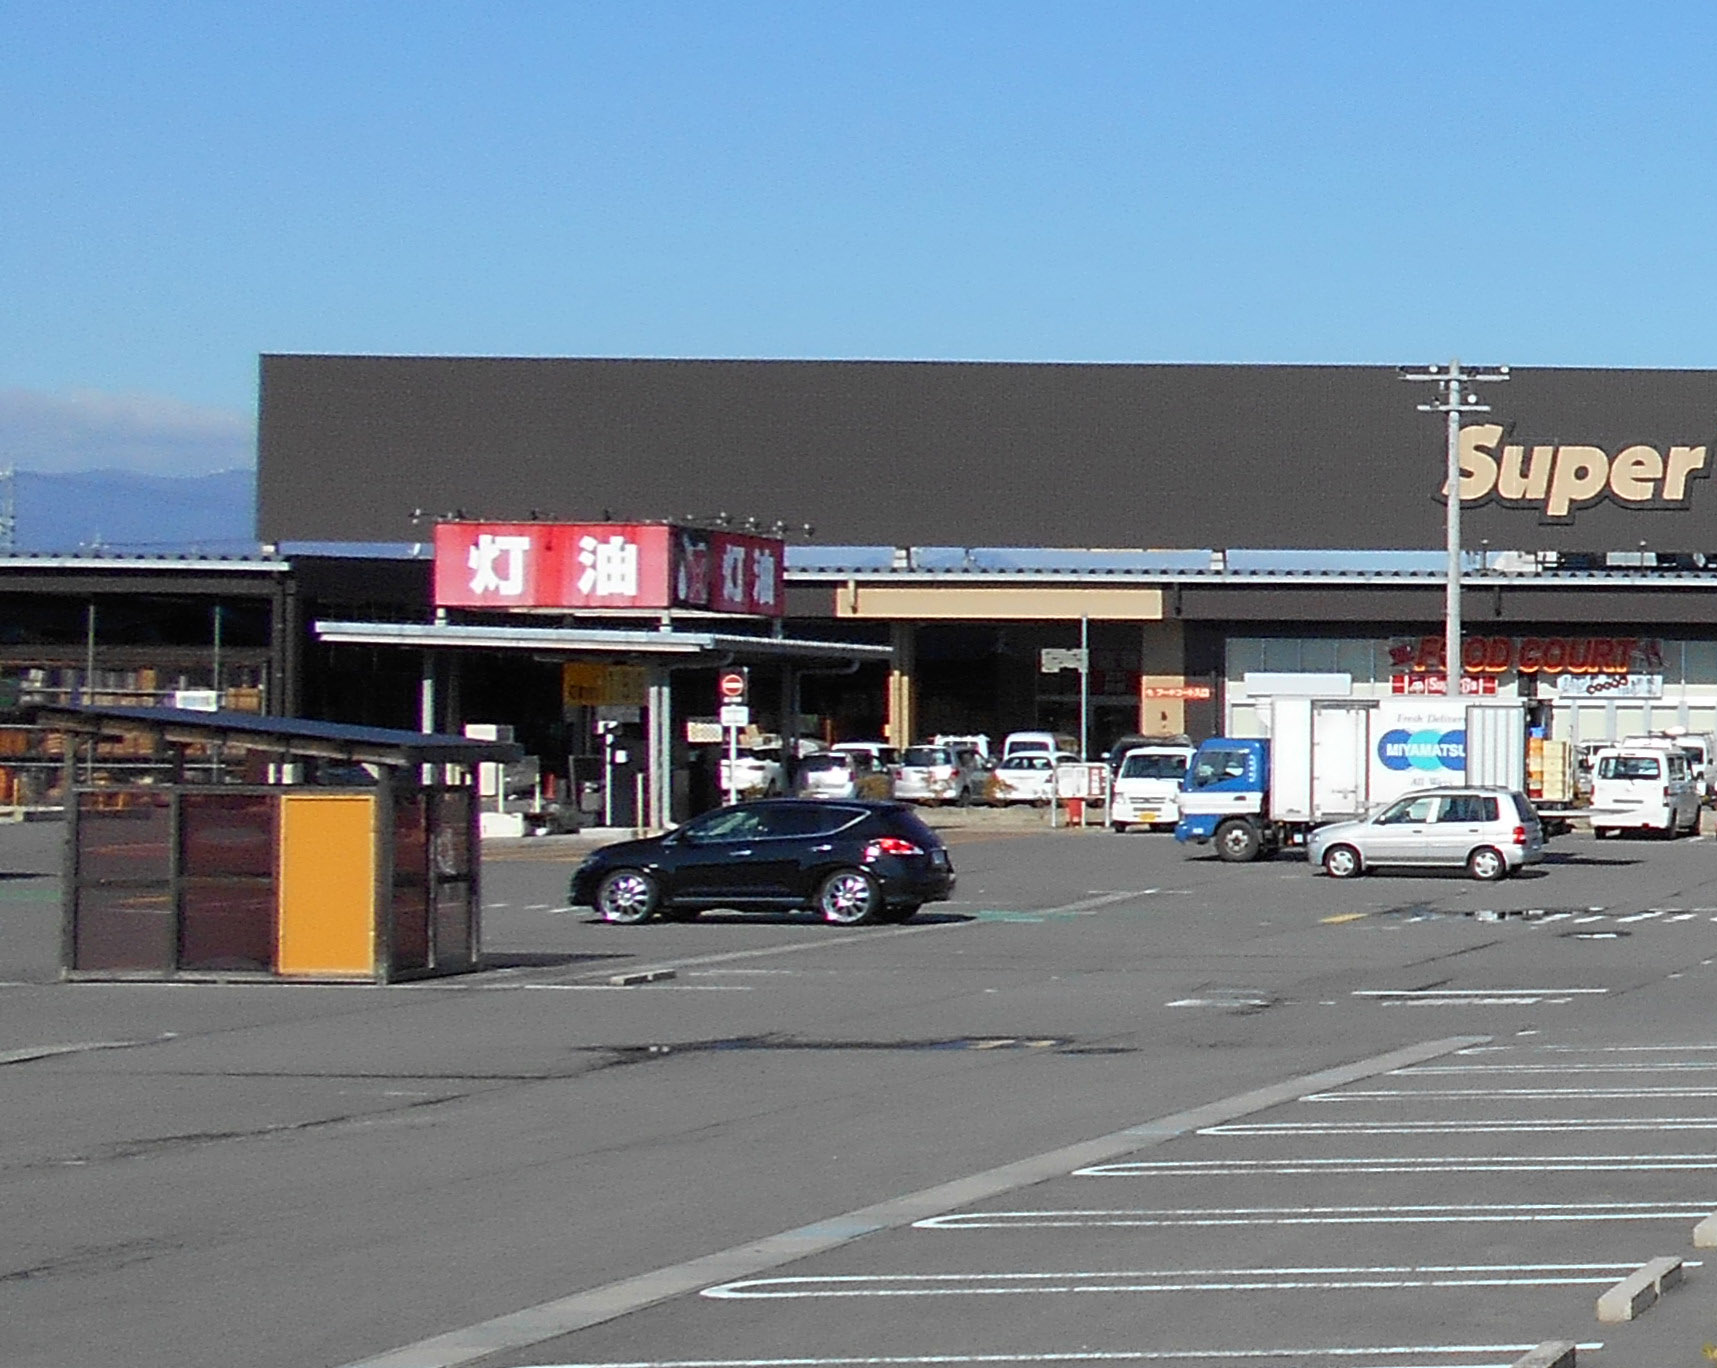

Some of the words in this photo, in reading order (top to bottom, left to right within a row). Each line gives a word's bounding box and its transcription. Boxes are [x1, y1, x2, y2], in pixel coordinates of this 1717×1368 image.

[1442, 424, 1706, 516] Super
[468, 535, 638, 596] 灯油
[722, 545, 775, 606] 灯油
[1518, 637, 1637, 673] COURT
